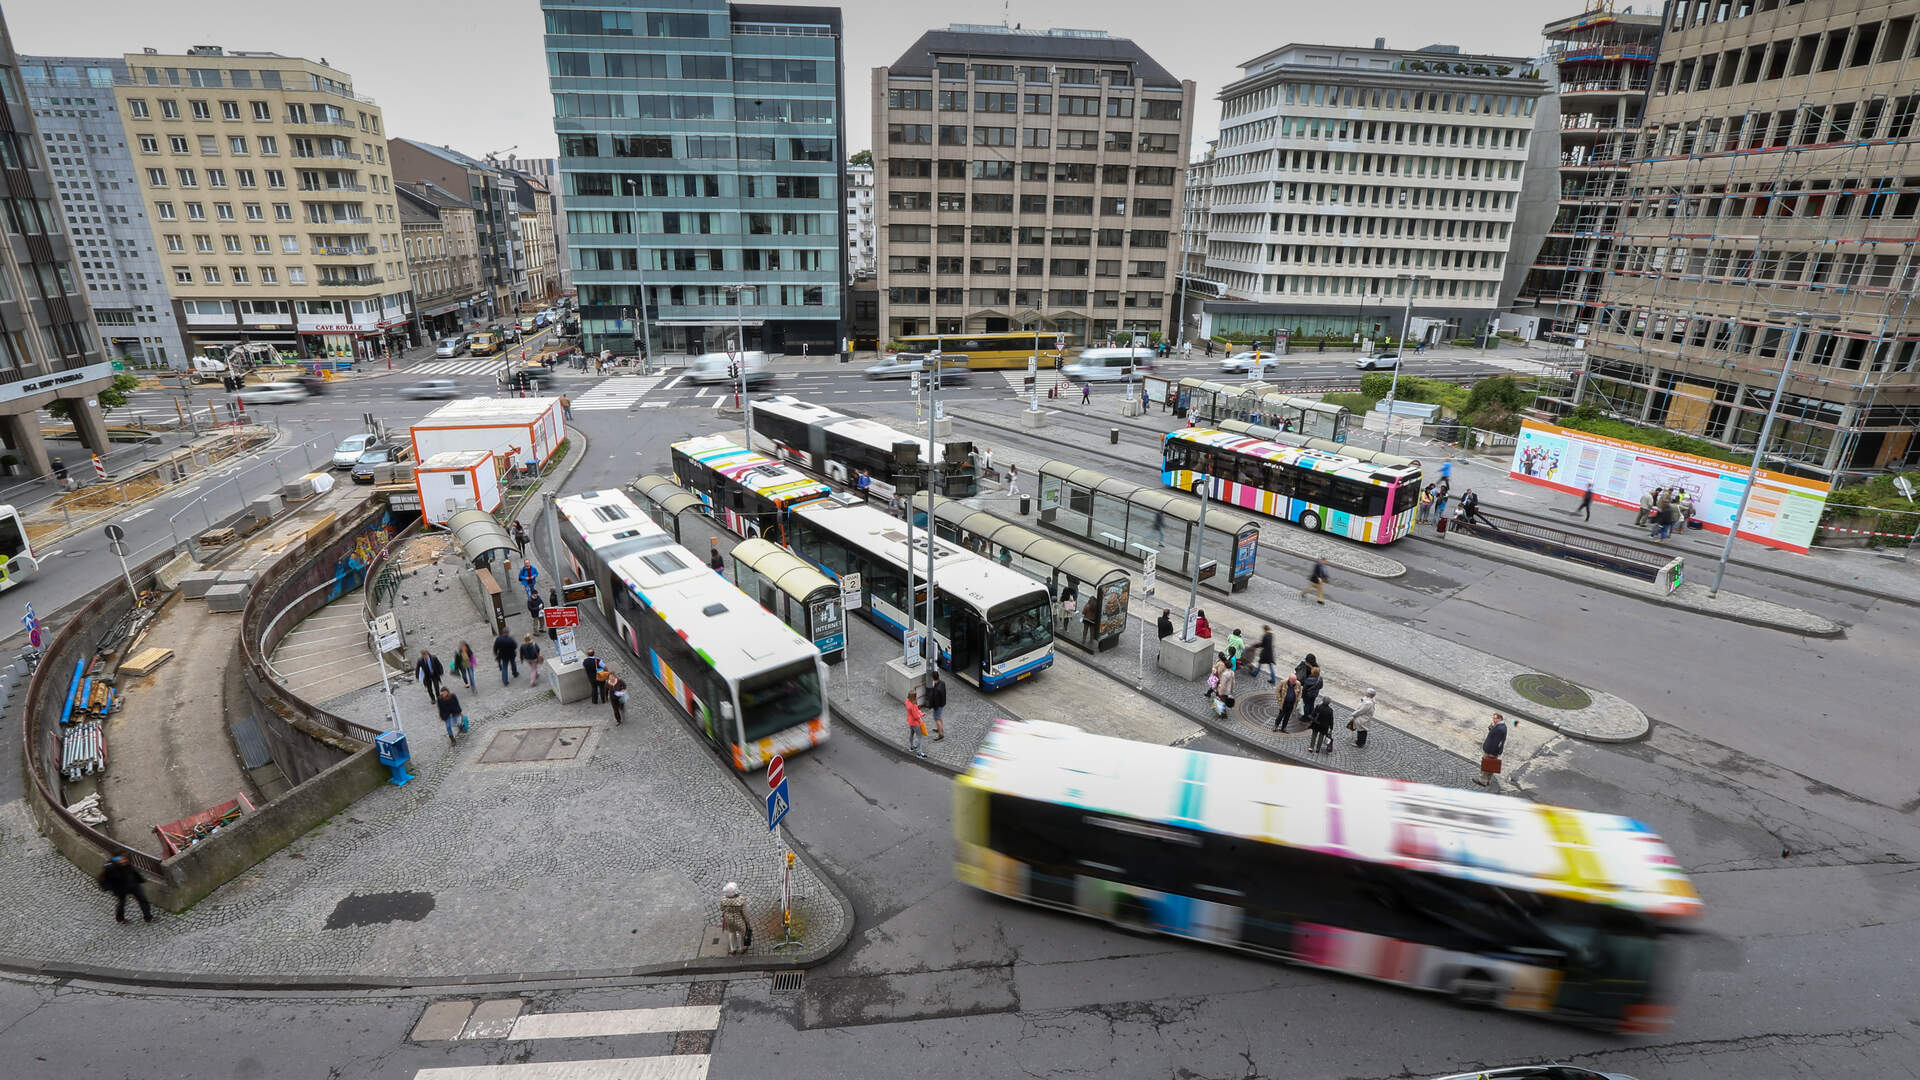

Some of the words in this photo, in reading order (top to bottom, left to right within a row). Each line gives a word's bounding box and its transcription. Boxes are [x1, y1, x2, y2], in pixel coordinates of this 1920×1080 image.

[54, 372, 85, 385] PARIBAS
[850, 581, 856, 589] 2
[820, 602, 837, 622] #1
[378, 614, 392, 624] QUAI
[815, 620, 842, 634] INTERNET
